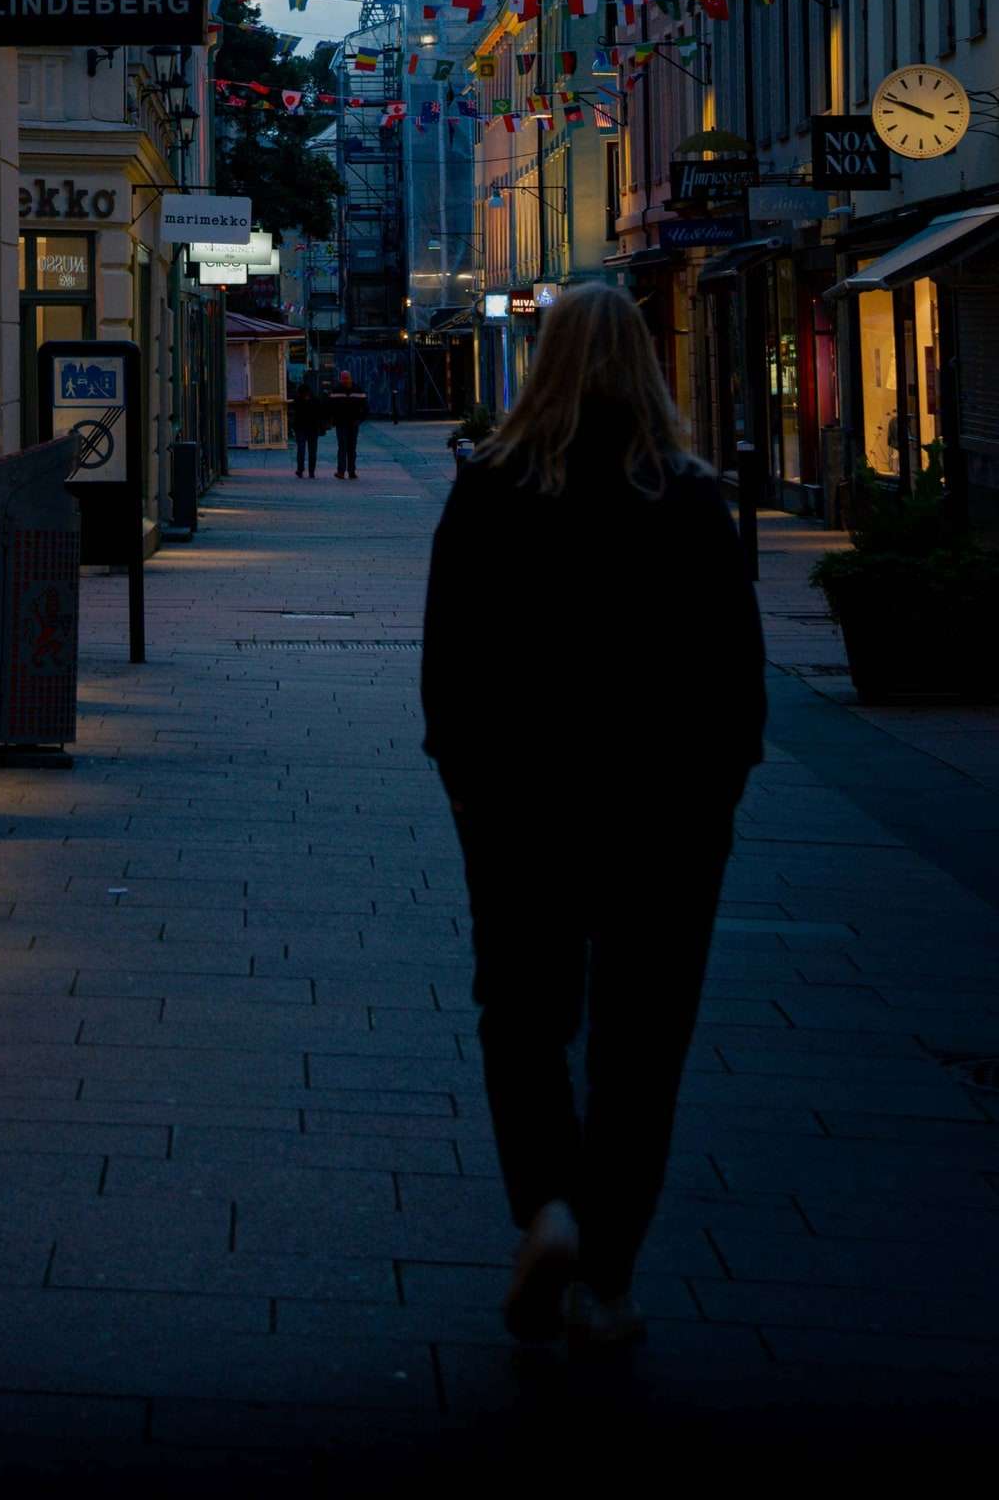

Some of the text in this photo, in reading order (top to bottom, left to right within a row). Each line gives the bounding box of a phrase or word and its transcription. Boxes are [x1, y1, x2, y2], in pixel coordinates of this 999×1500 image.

[824, 131, 878, 150] NOA
[824, 154, 879, 175] NOA
[165, 213, 248, 227] marimekko
[512, 299, 535, 307] MIVA
